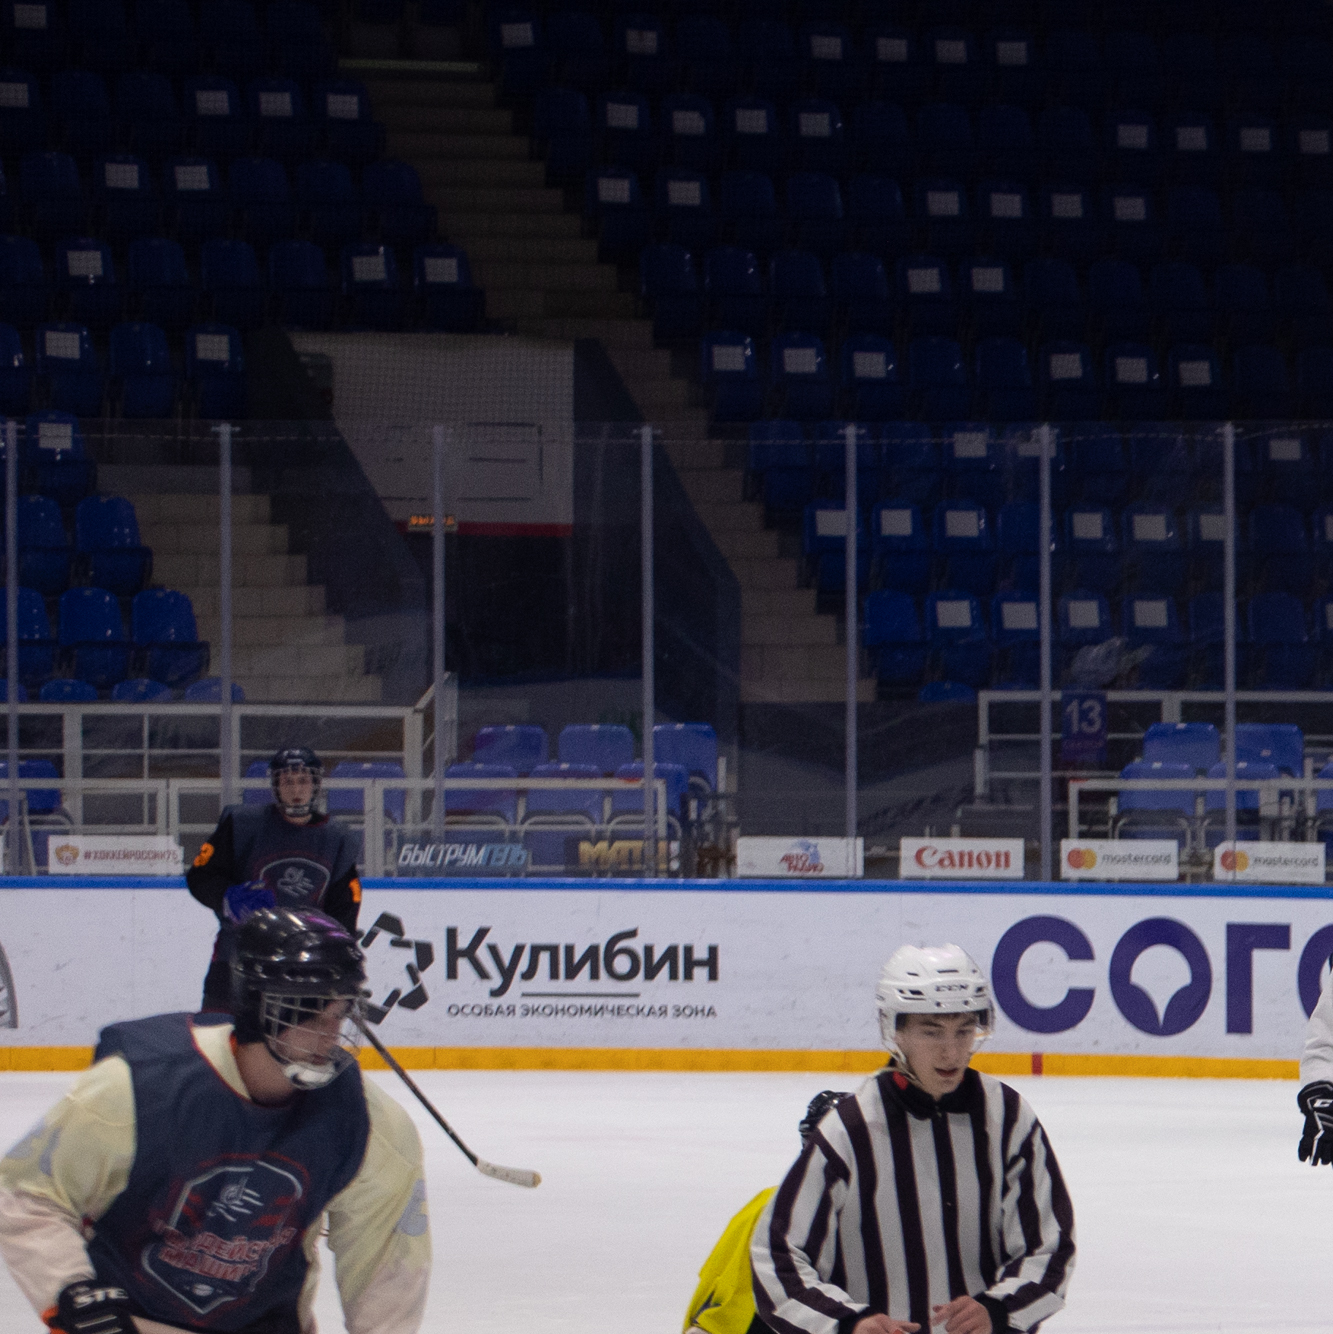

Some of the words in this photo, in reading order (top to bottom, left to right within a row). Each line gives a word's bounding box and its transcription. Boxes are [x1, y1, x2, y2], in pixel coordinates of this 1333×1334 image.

[1065, 698, 1102, 735] 13
[915, 846, 1011, 869] Canon
[445, 926, 720, 998] Кулибин
[446, 1003, 516, 1019] ОСОБАЯ
[520, 1003, 668, 1019] ЭКОНОМИЧЕСКАЯ
[672, 1004, 718, 1019] ЗОНА
